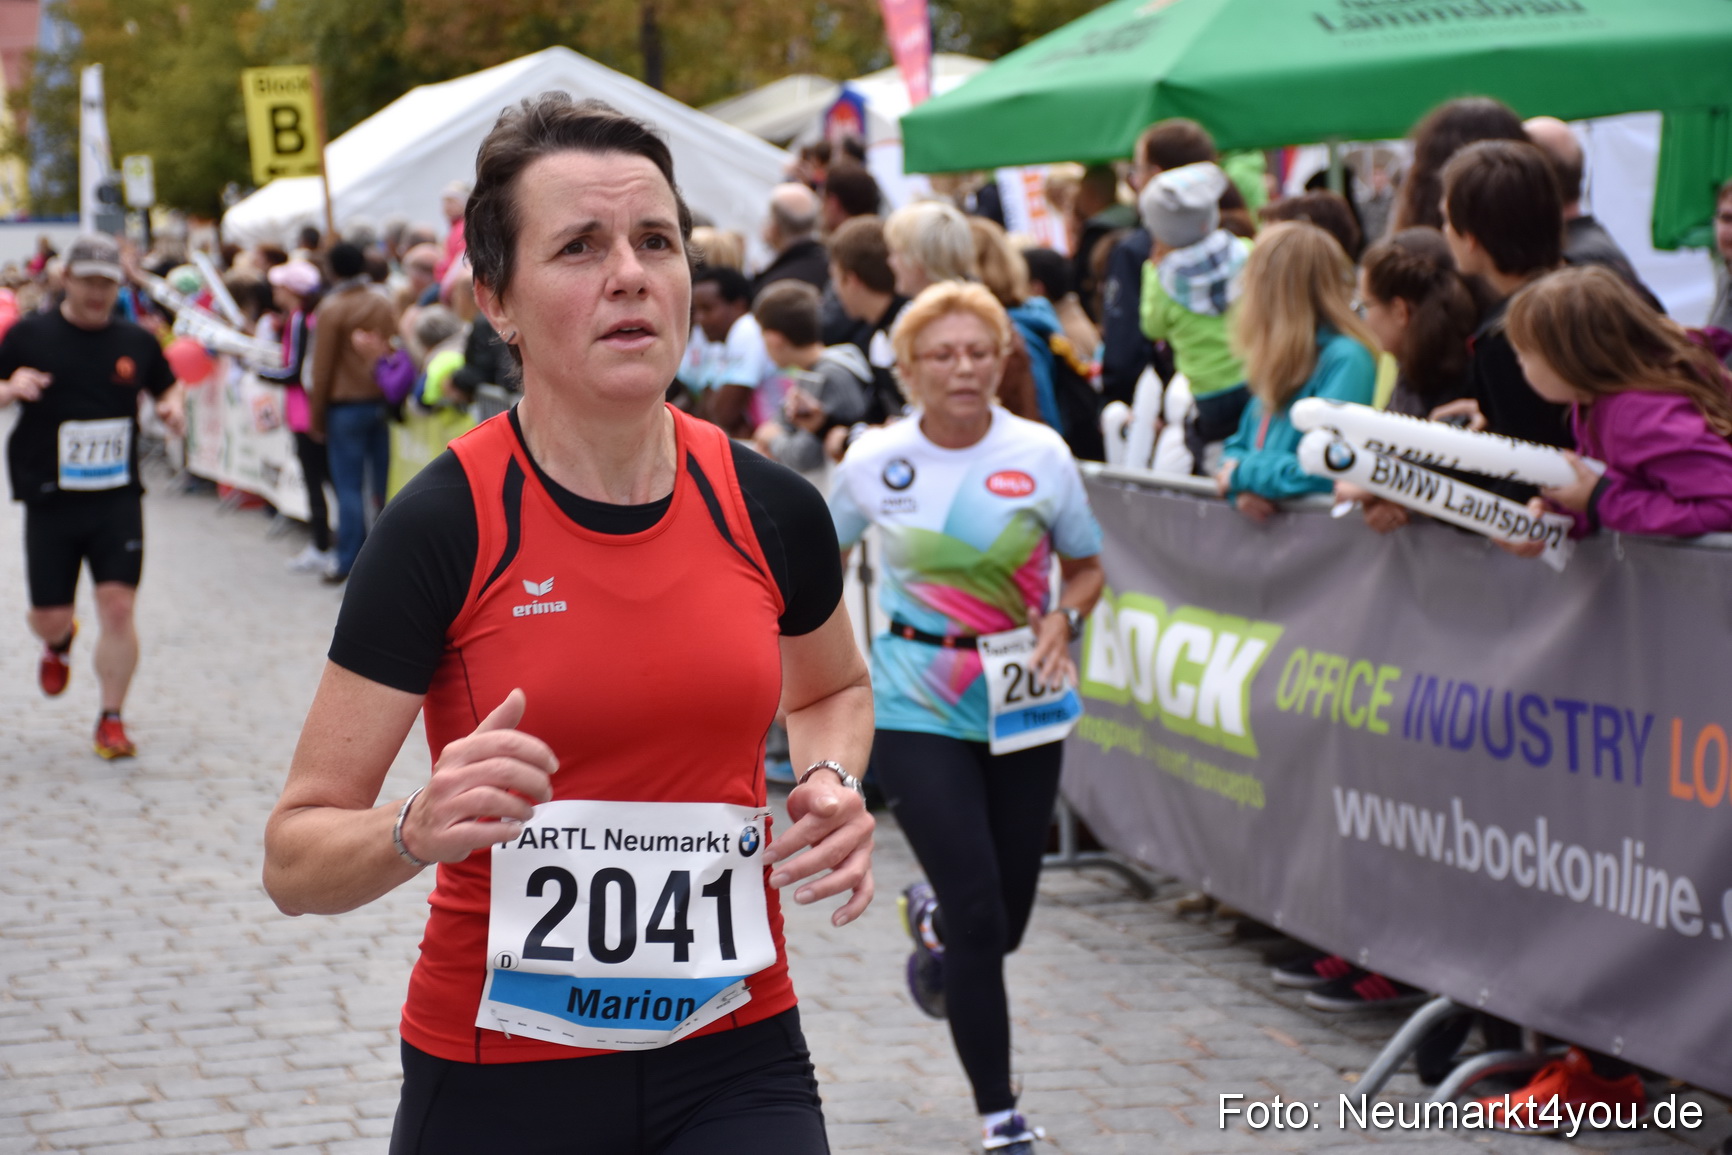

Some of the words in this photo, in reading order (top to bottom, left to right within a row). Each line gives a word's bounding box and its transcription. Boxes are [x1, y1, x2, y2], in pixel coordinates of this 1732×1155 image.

[269, 104, 307, 156] B
[1370, 454, 1441, 502] BMW
[512, 600, 568, 617] erima
[1086, 597, 1267, 737] BOCK
[1276, 647, 1401, 735] OFFICE
[1403, 672, 1656, 787] INDUSTRY
[1669, 716, 1732, 809] LO
[501, 827, 595, 851] ARTL
[604, 828, 730, 853] Neumarkt
[522, 866, 738, 964] 2041
[500, 954, 511, 969] D
[567, 986, 696, 1022] Marion
